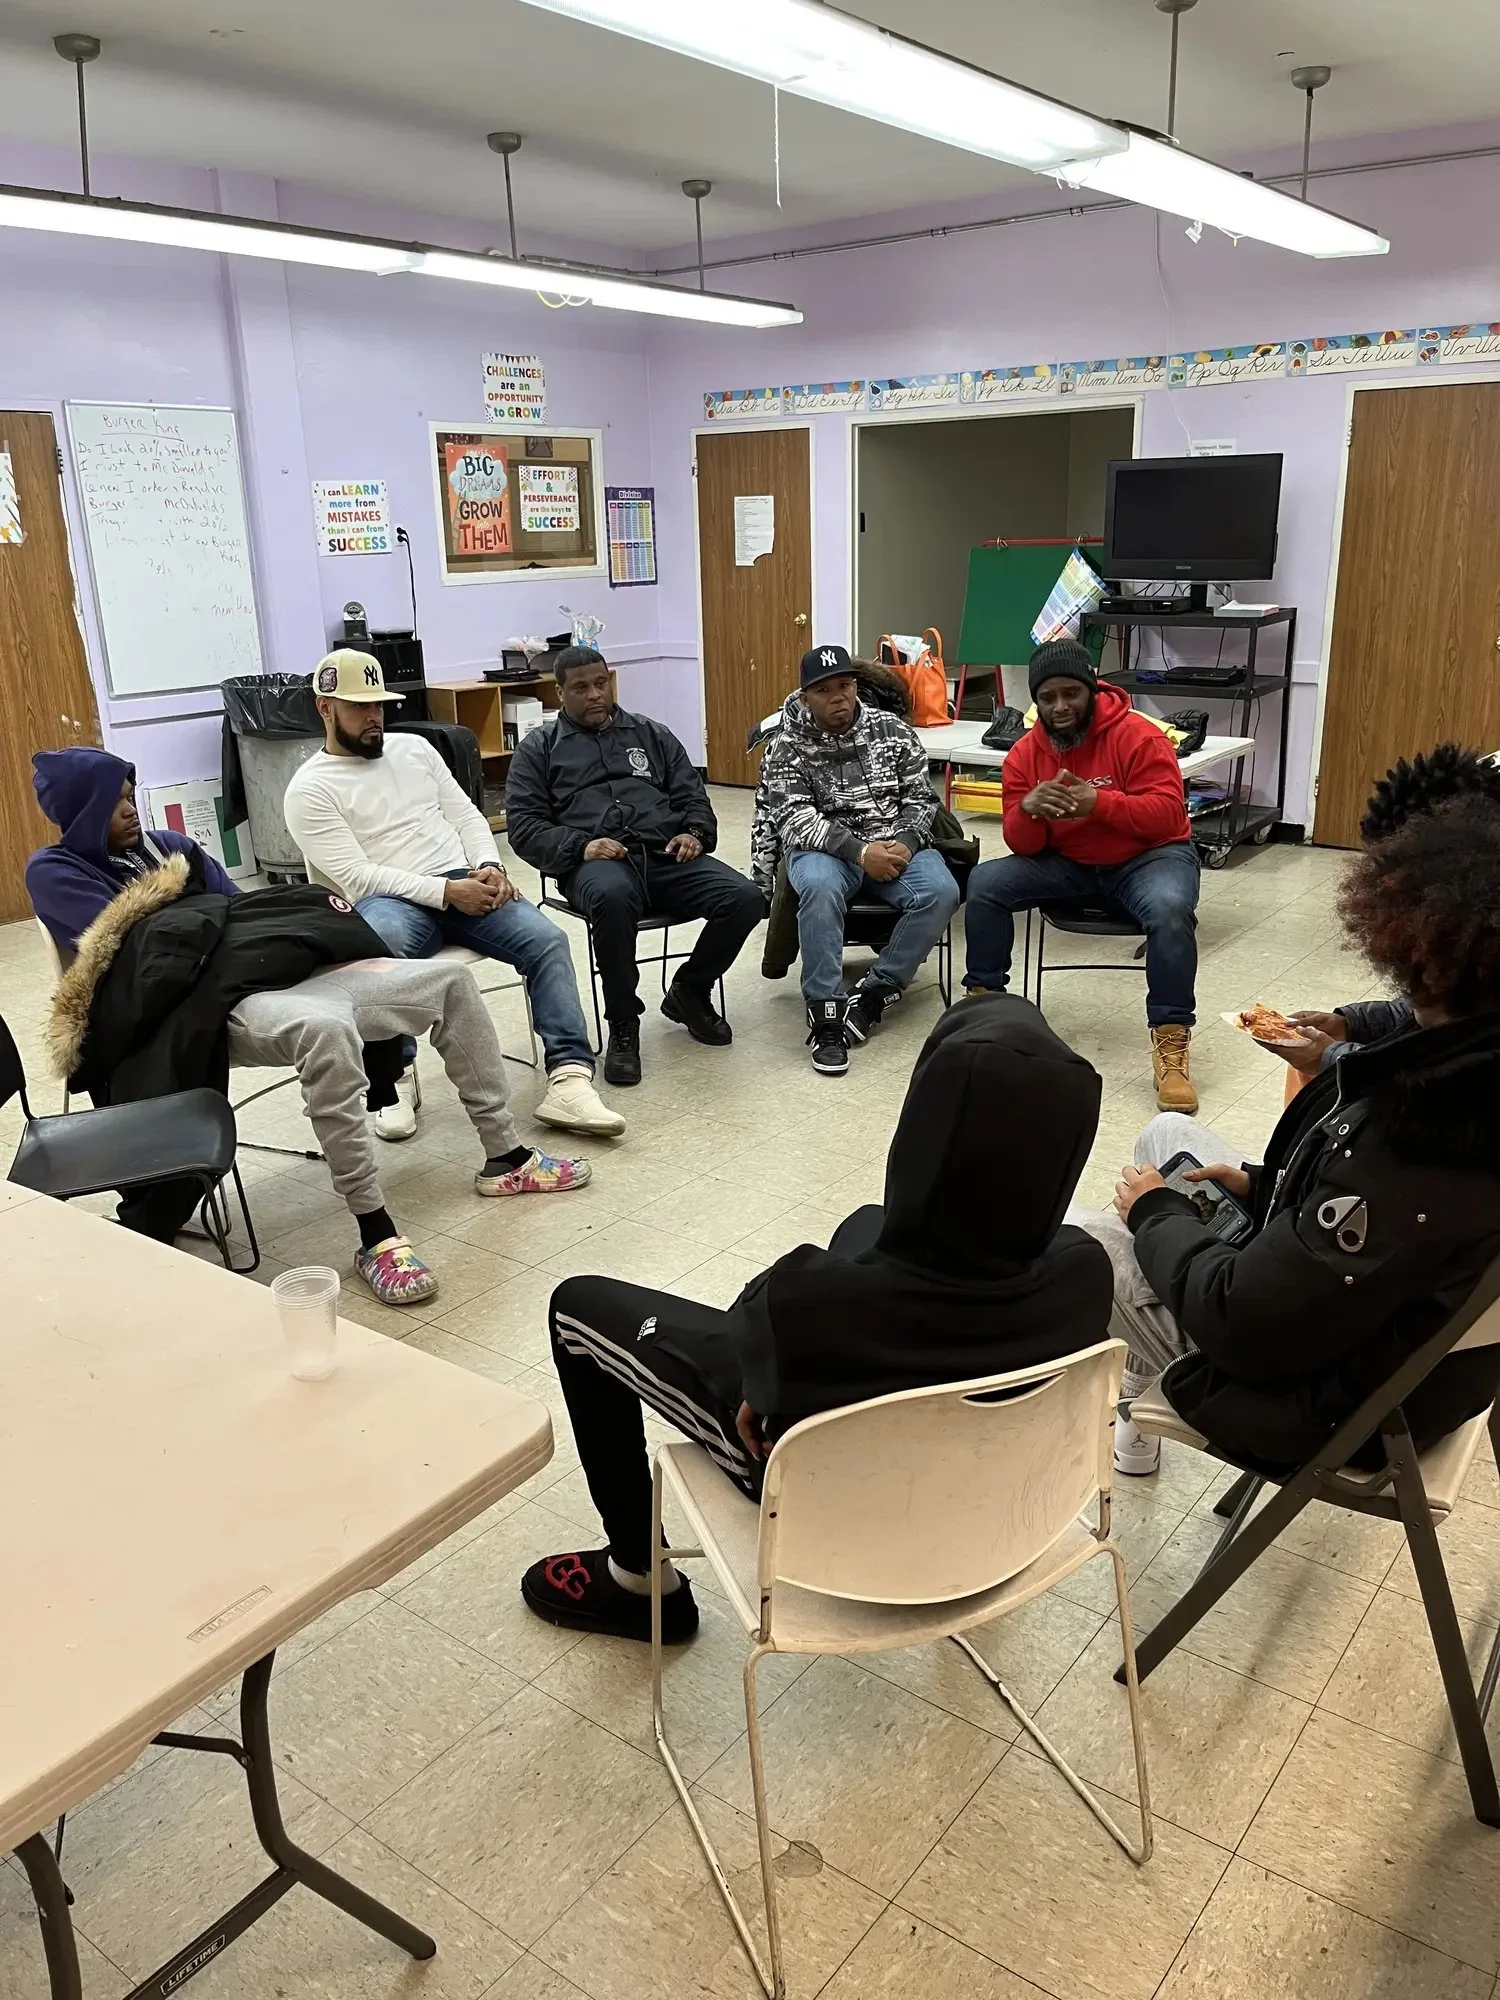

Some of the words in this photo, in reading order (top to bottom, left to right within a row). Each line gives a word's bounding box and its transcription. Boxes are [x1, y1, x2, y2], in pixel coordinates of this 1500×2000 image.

[1308, 350, 1340, 367] Ss
[1343, 347, 1373, 364] Tt
[1375, 345, 1413, 361] Uu
[487, 366, 541, 378] CHALLENGES
[1188, 362, 1216, 385] Pp
[1218, 358, 1247, 381] Qq
[1247, 356, 1284, 373] Rr
[1078, 372, 1110, 387] Mm
[1113, 370, 1141, 384] Nn
[1143, 367, 1164, 383] Oo
[501, 382, 515, 390] are
[1000, 376, 1029, 392] Kk
[488, 393, 543, 403] OPPORTUNITY
[494, 407, 505, 417] to
[508, 407, 541, 418] GROW
[463, 456, 494, 476] BIG
[533, 470, 565, 480] EFFORT
[342, 485, 379, 495] LEARN
[459, 476, 501, 492] DREAMS
[546, 482, 553, 492] &
[619, 490, 641, 499] Division
[355, 499, 376, 507] from
[460, 500, 502, 520] GROW
[551, 505, 564, 514] keys
[328, 511, 381, 523] MISTAKES
[528, 516, 574, 528] SUCCESS
[366, 525, 384, 533] from
[459, 523, 509, 550] THEM
[328, 536, 387, 552] SUCCESS
[168, 1942, 218, 1987] LIFETIME
